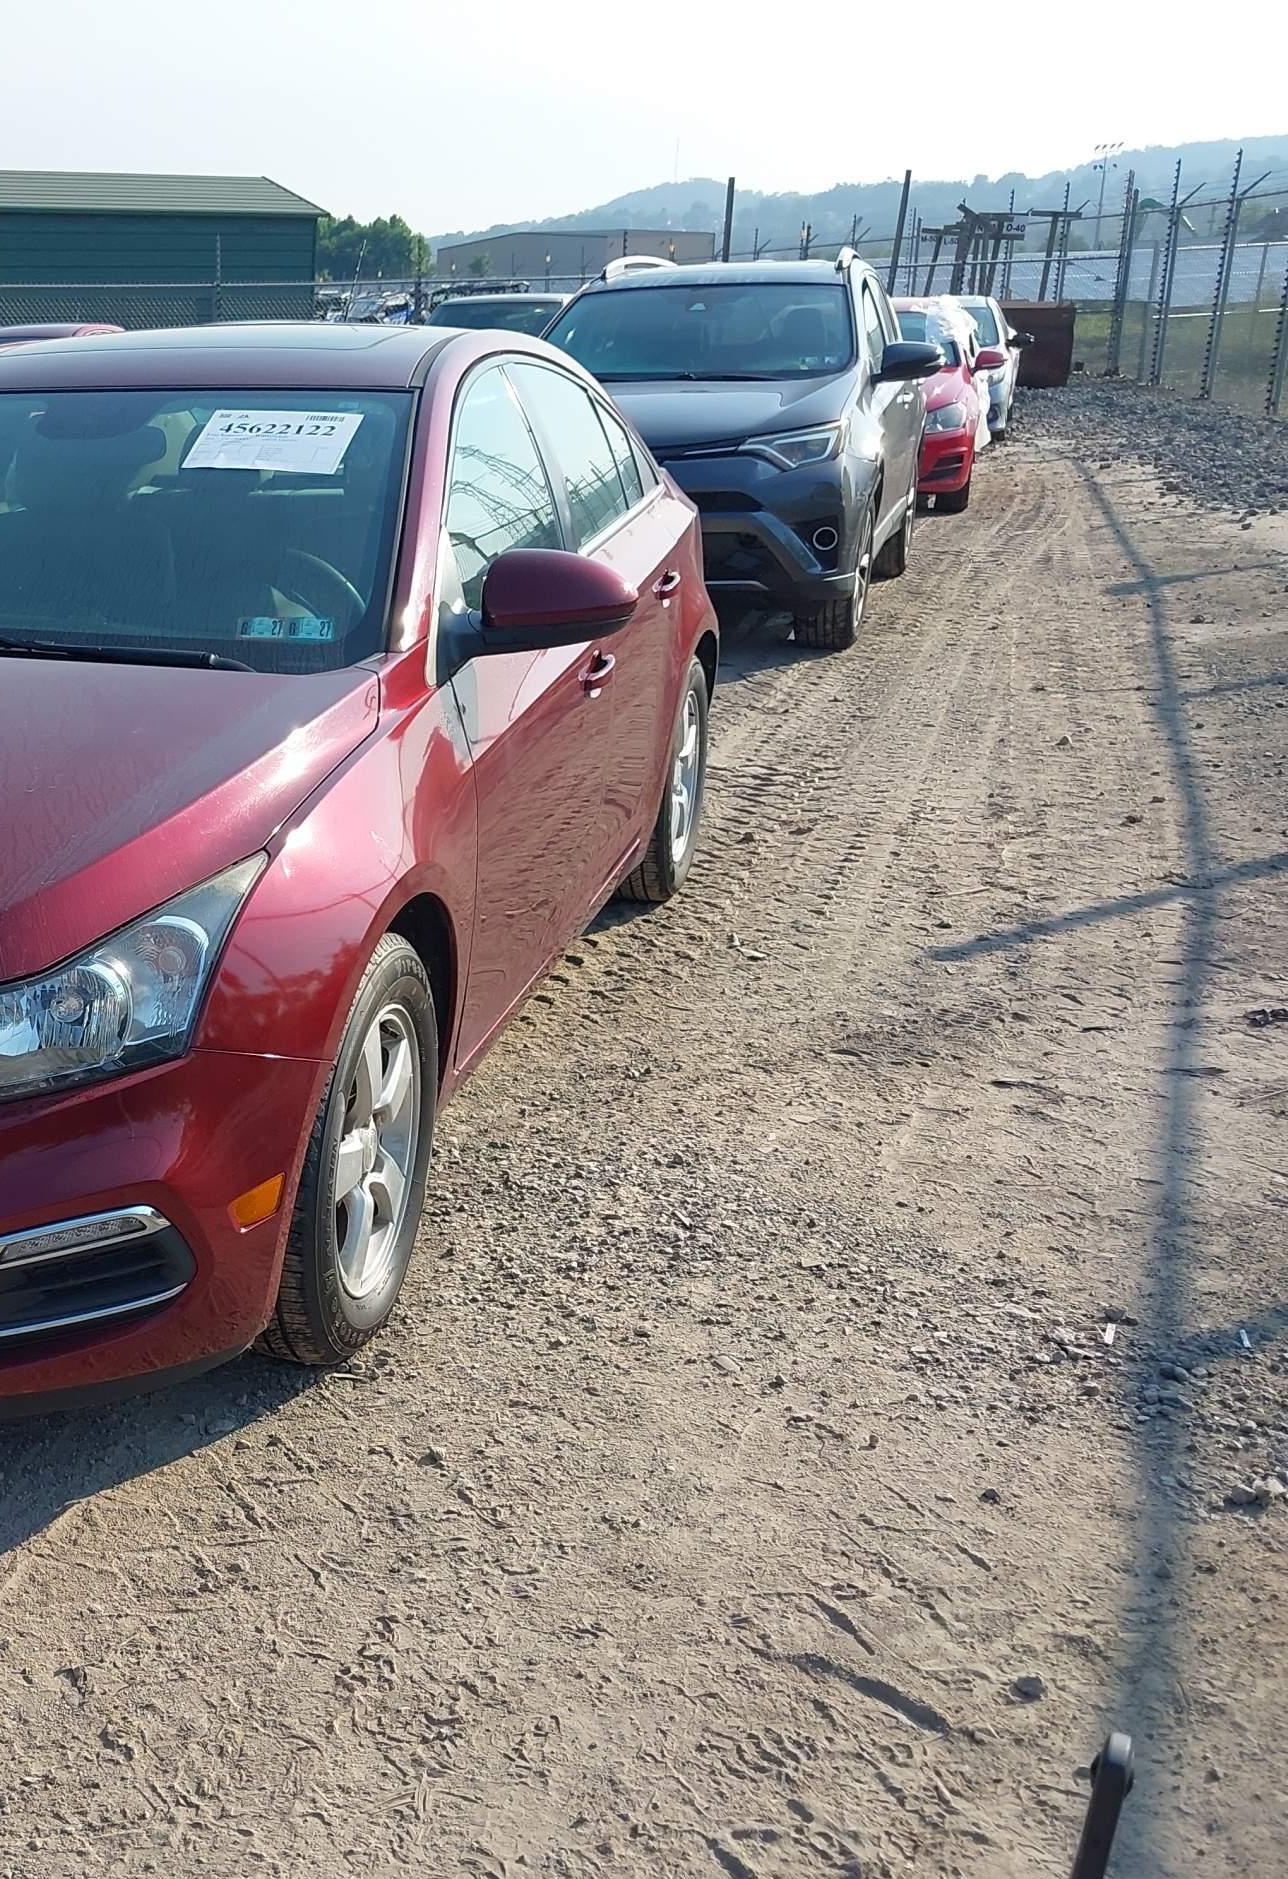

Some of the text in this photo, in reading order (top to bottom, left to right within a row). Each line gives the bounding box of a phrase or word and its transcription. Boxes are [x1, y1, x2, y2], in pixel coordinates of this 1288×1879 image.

[219, 422, 337, 437] 45622122
[271, 619, 284, 636] 27
[319, 621, 332, 637] 27
